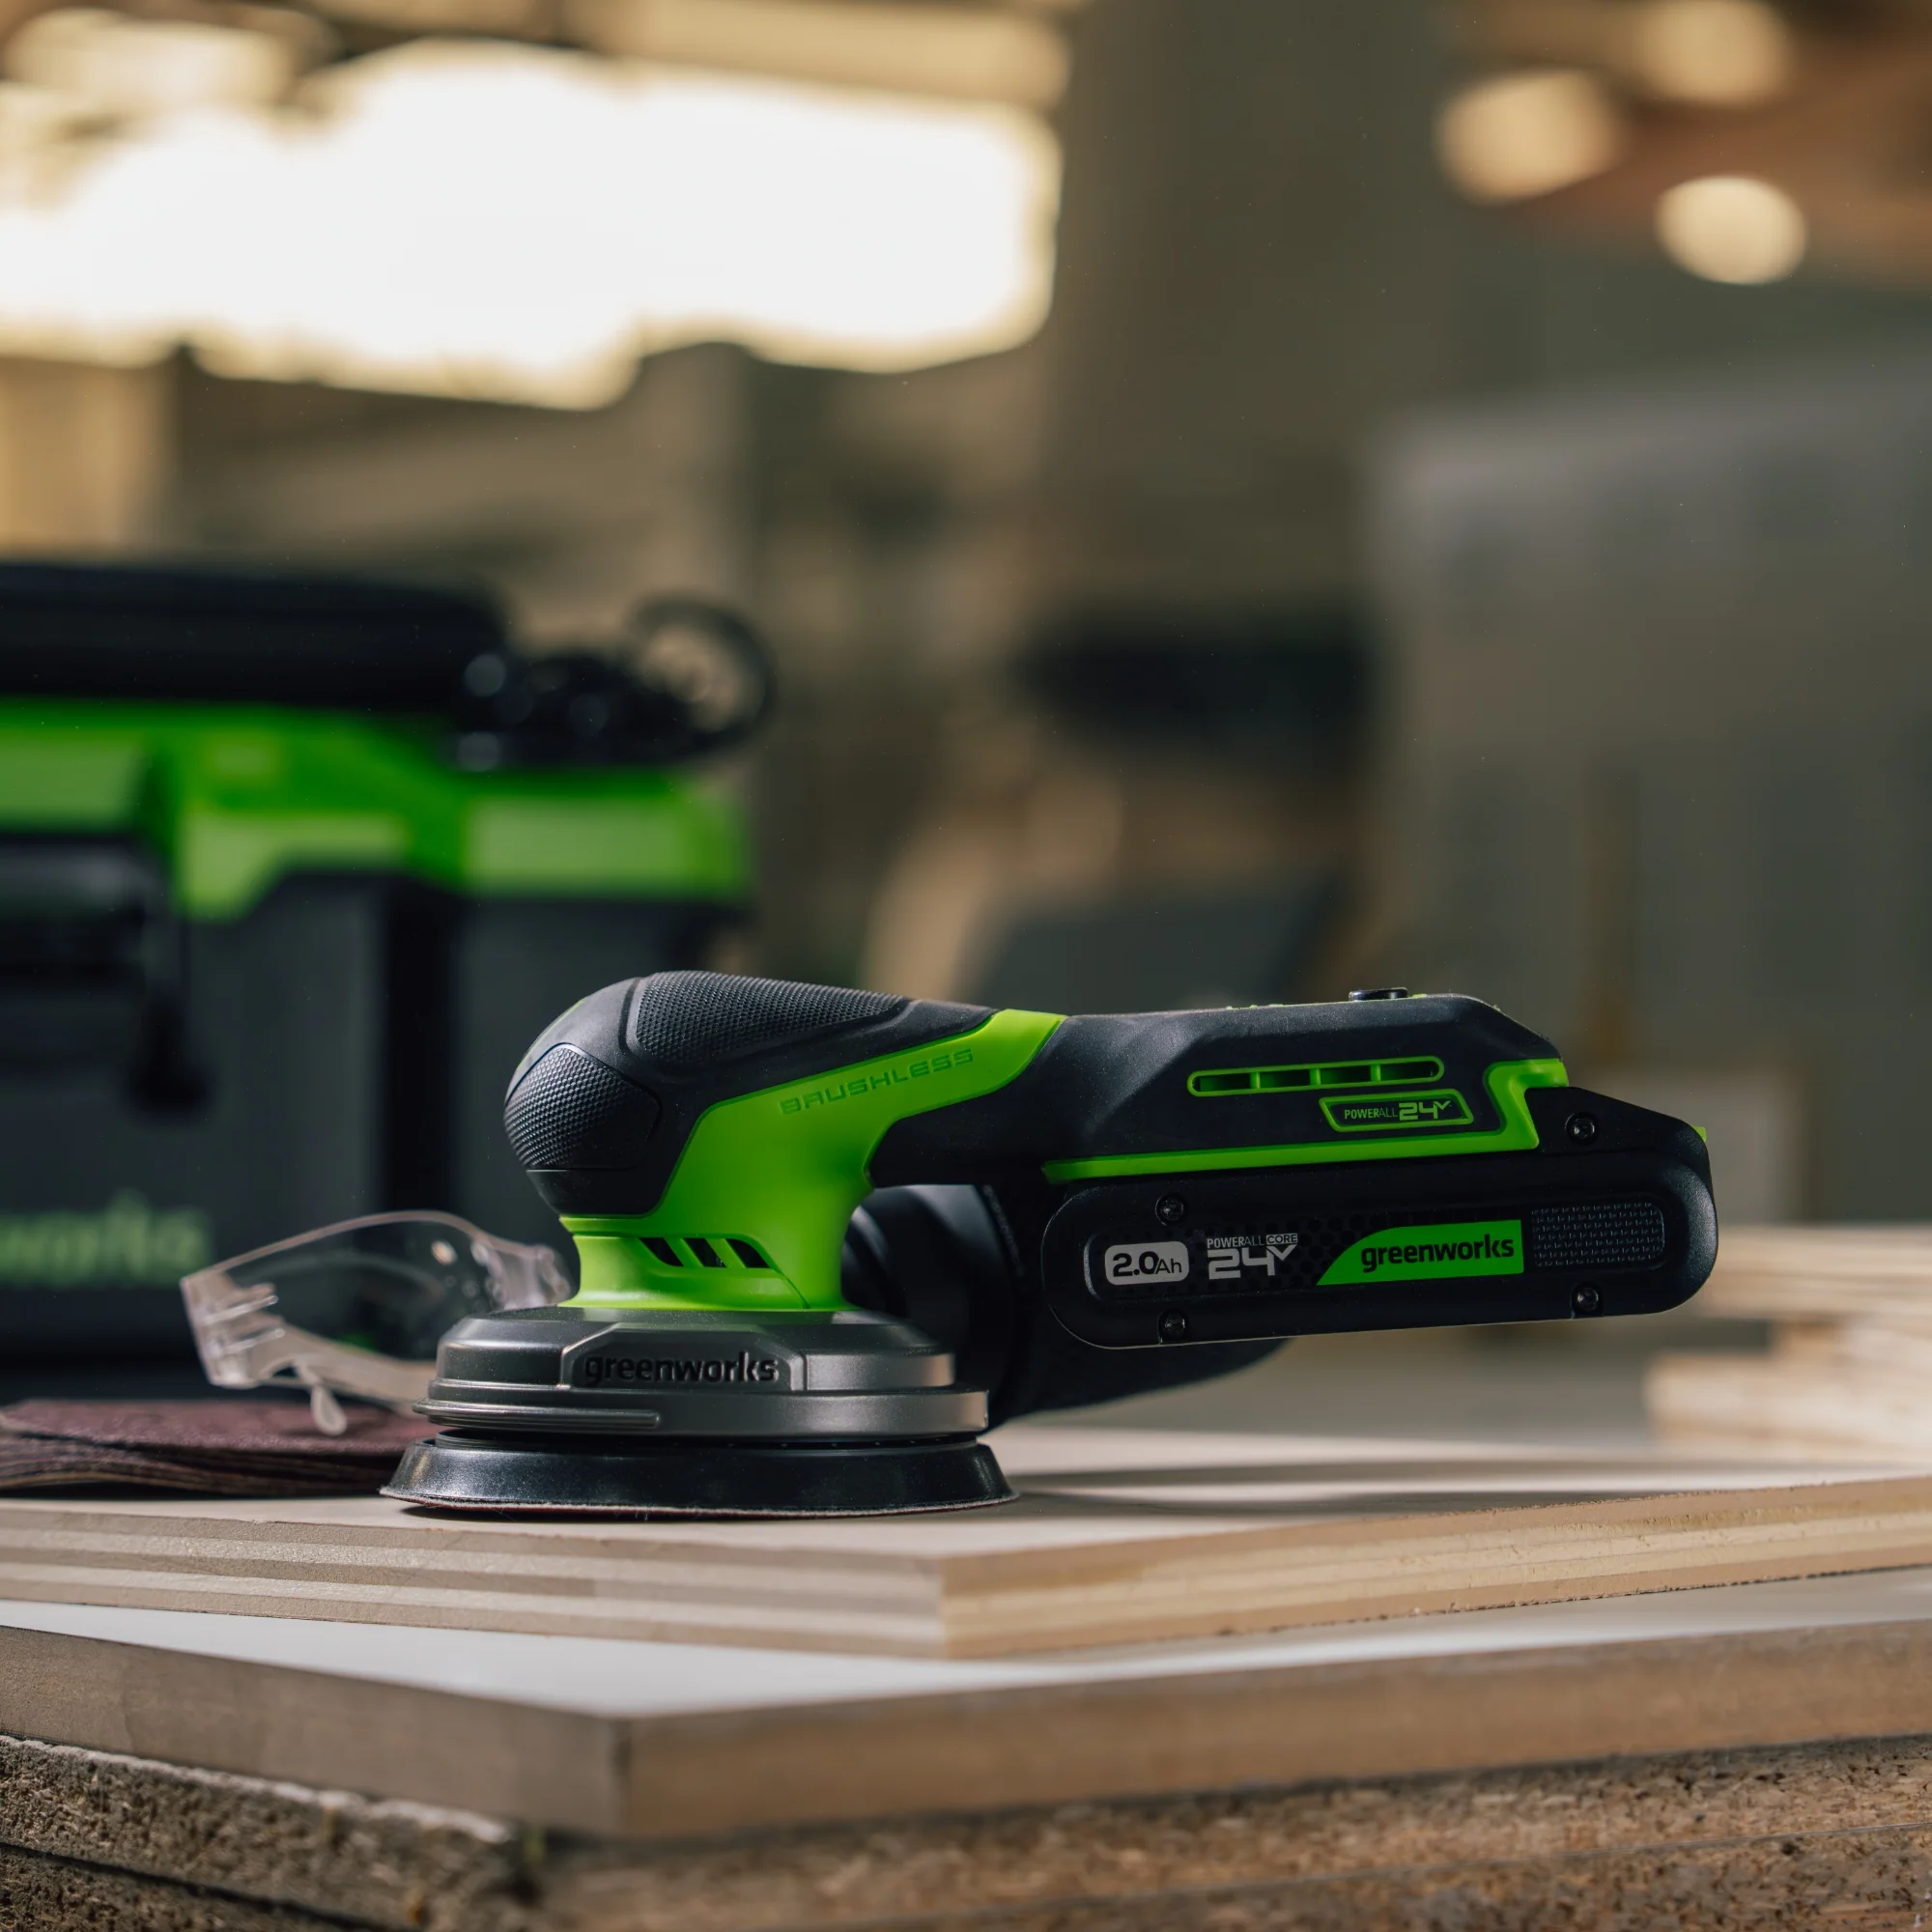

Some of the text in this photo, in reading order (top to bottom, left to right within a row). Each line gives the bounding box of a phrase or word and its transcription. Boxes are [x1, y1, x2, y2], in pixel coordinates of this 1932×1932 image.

[778, 1048, 974, 1115] BRUSHLESS
[1344, 1107, 1398, 1120] POWERALL
[1207, 1234, 1297, 1249] POWERALL CORE
[1360, 1234, 1515, 1273] greenworks
[1112, 1250, 1182, 1278] 2.0Ah
[584, 1350, 780, 1387] greenworks
